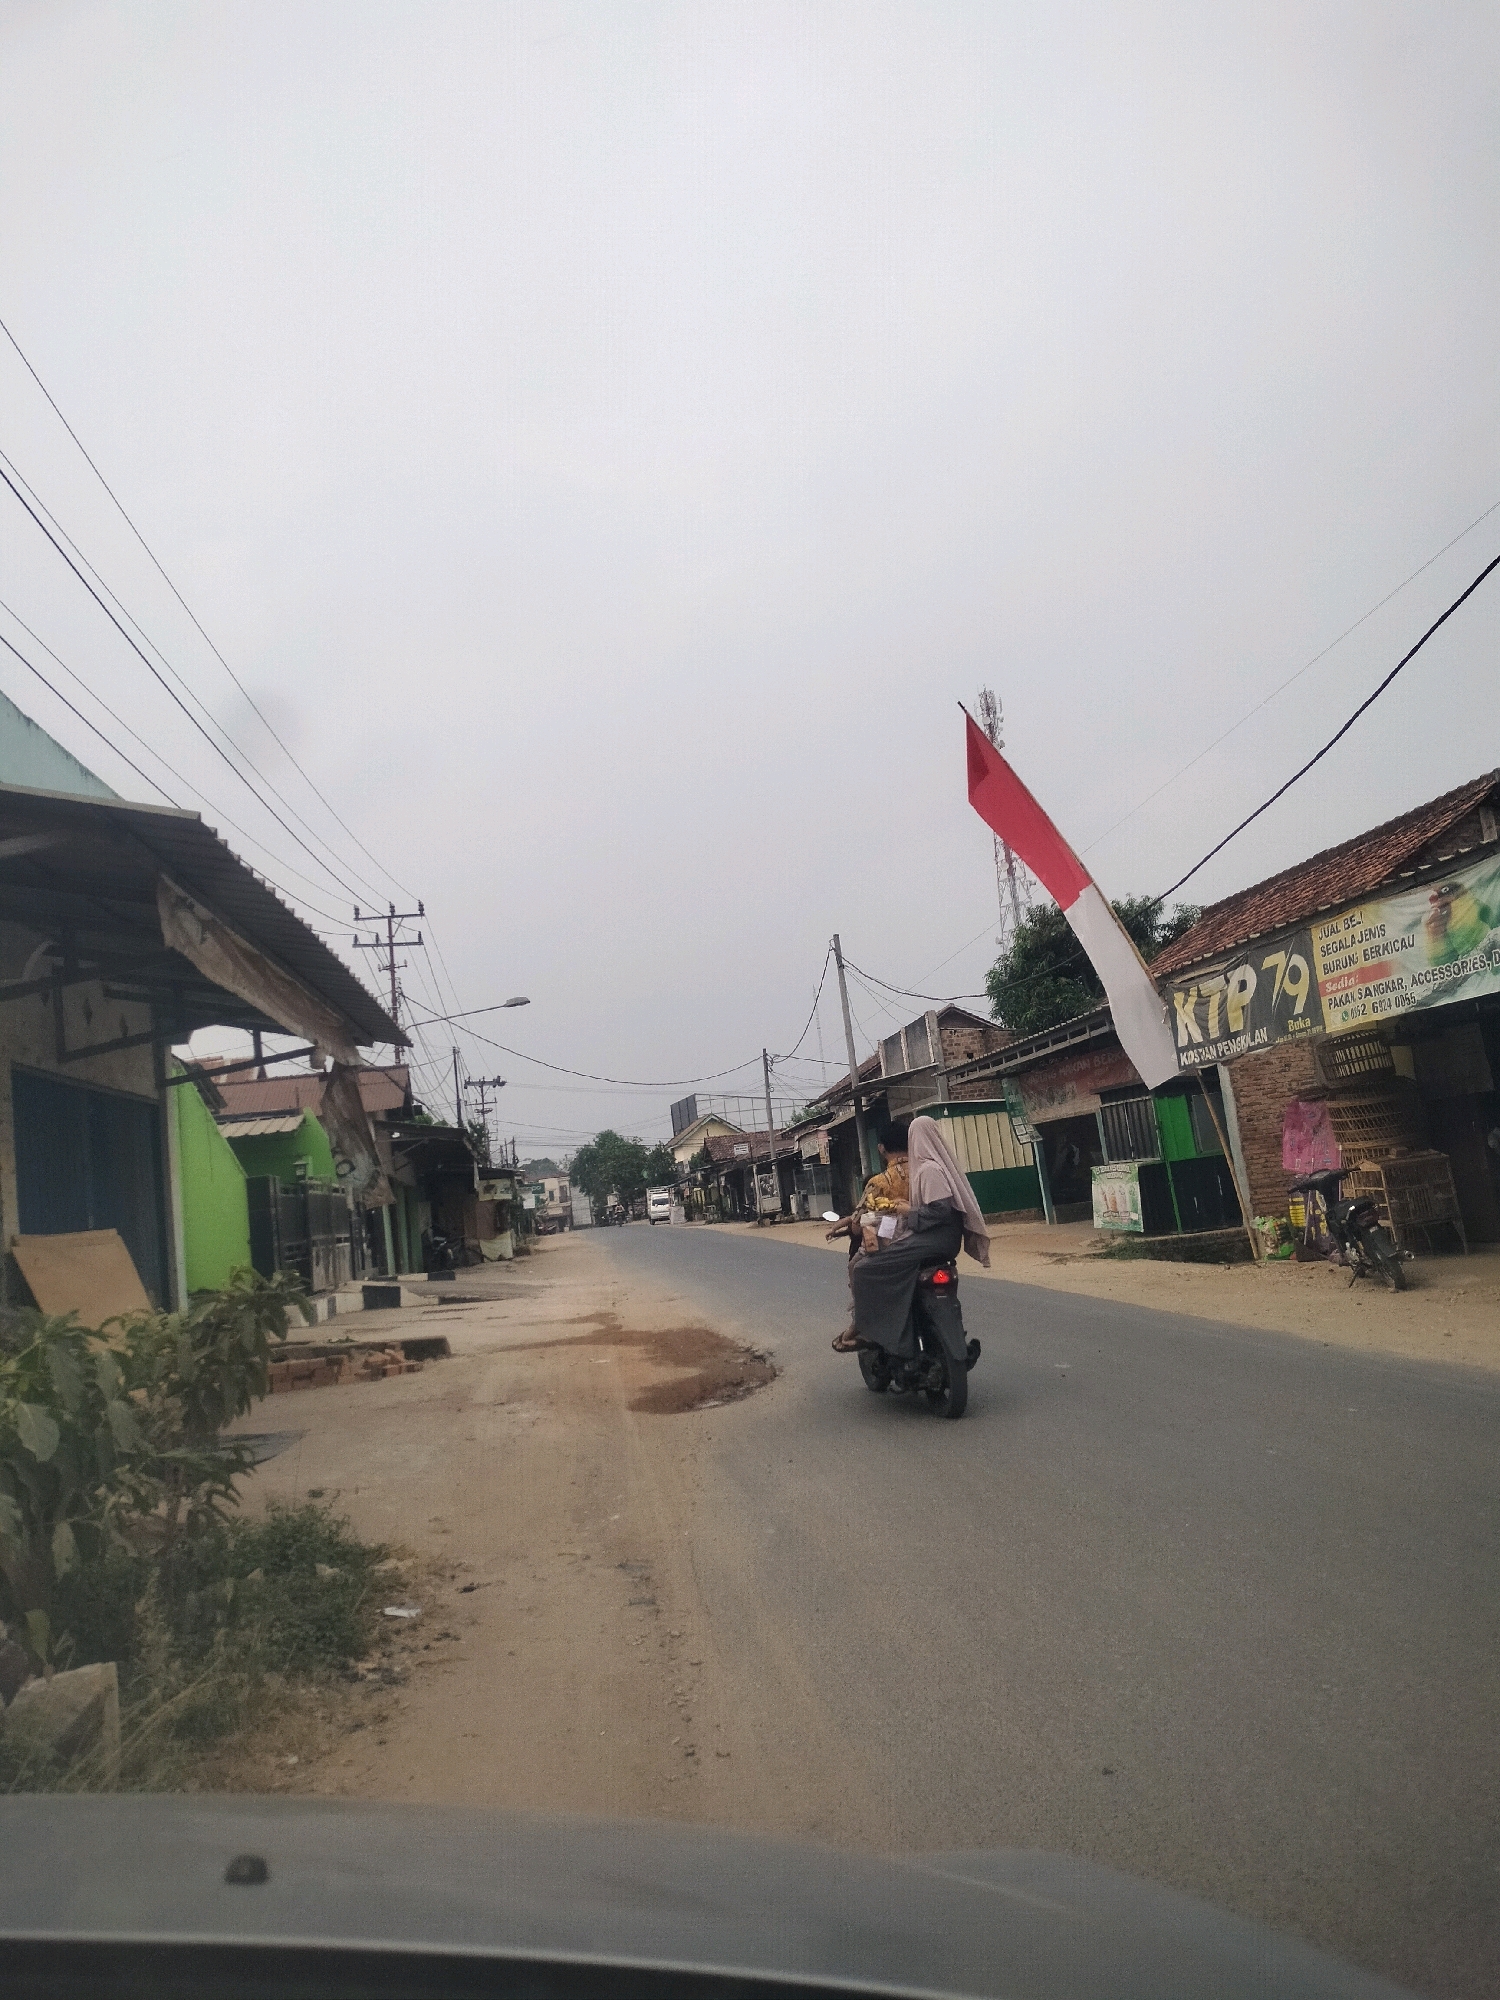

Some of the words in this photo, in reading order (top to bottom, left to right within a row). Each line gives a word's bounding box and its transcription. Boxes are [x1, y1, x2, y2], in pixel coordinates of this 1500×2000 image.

[1318, 922, 1341, 940] JUAL
[1320, 934, 1356, 957] SEGALA
[1357, 923, 1386, 944] JENIS
[1362, 934, 1415, 962] BERKICAU
[1325, 974, 1359, 992] Sedia:
[1357, 977, 1408, 1000] SANGKAR,
[1410, 954, 1491, 988] ACCESSORIES,
[1174, 964, 1257, 1047] KTP
[1261, 950, 1310, 1017] 79
[1288, 1017, 1311, 1031] Buka
